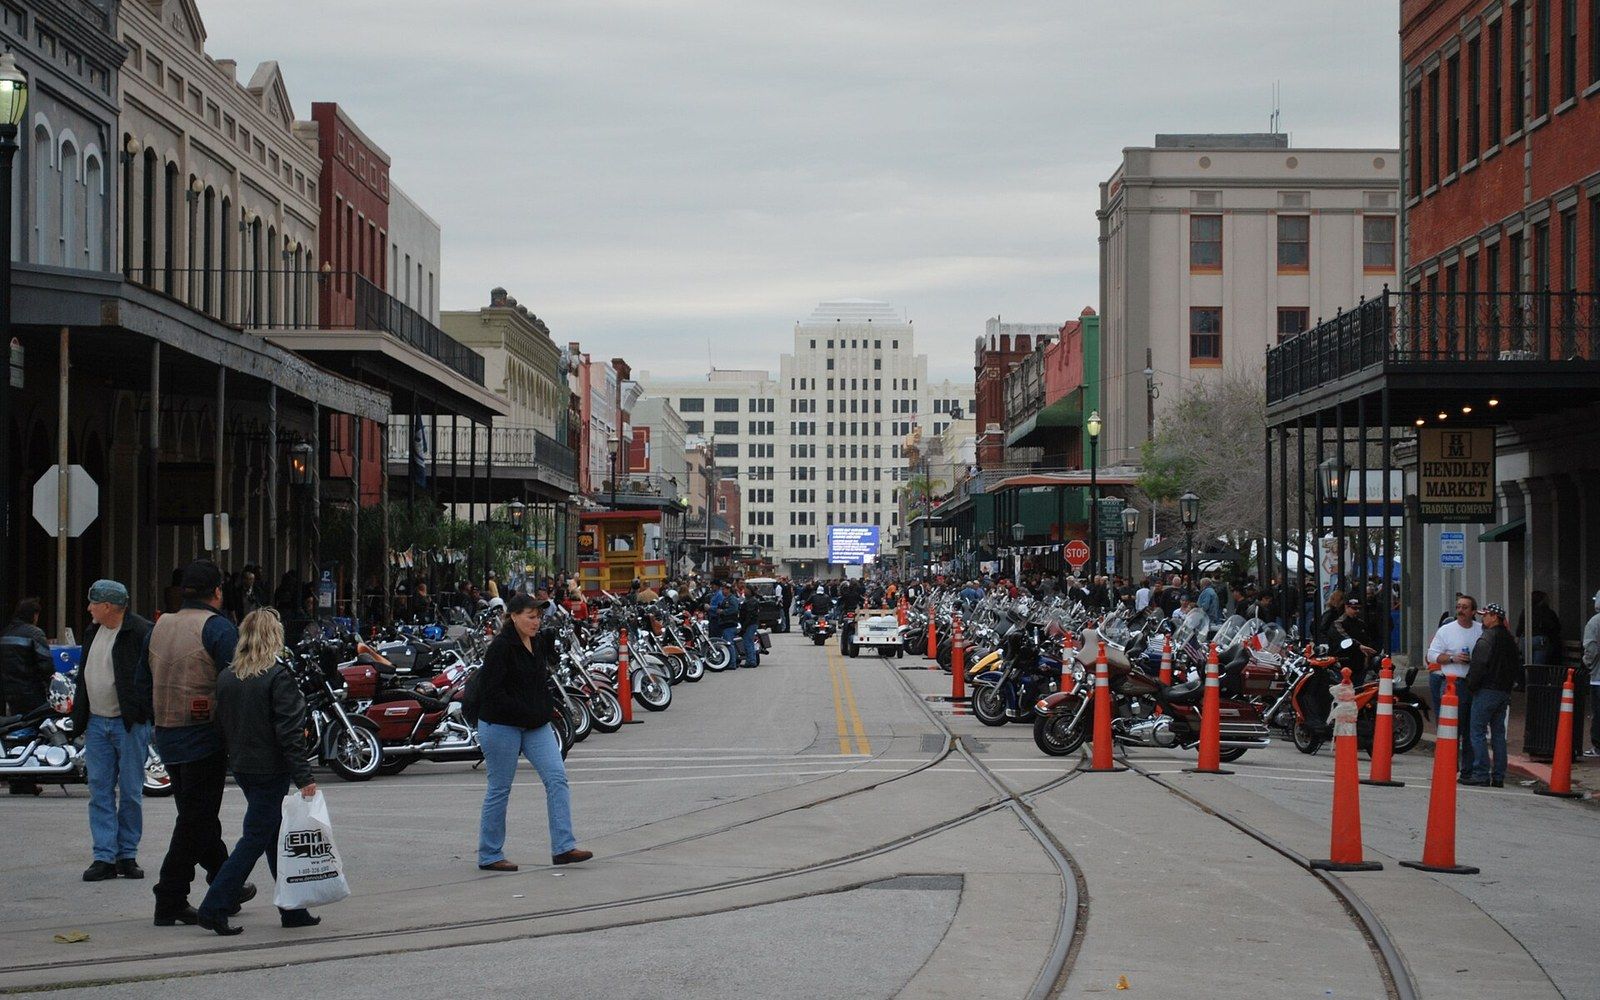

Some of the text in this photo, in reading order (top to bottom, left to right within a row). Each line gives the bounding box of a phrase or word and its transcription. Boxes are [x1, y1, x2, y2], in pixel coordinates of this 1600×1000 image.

[1422, 462, 1491, 477] HENDLEY
[1426, 481, 1487, 497] MARKET
[1421, 504, 1493, 514] TRADING COMPANY
[1066, 548, 1088, 558] STOP
